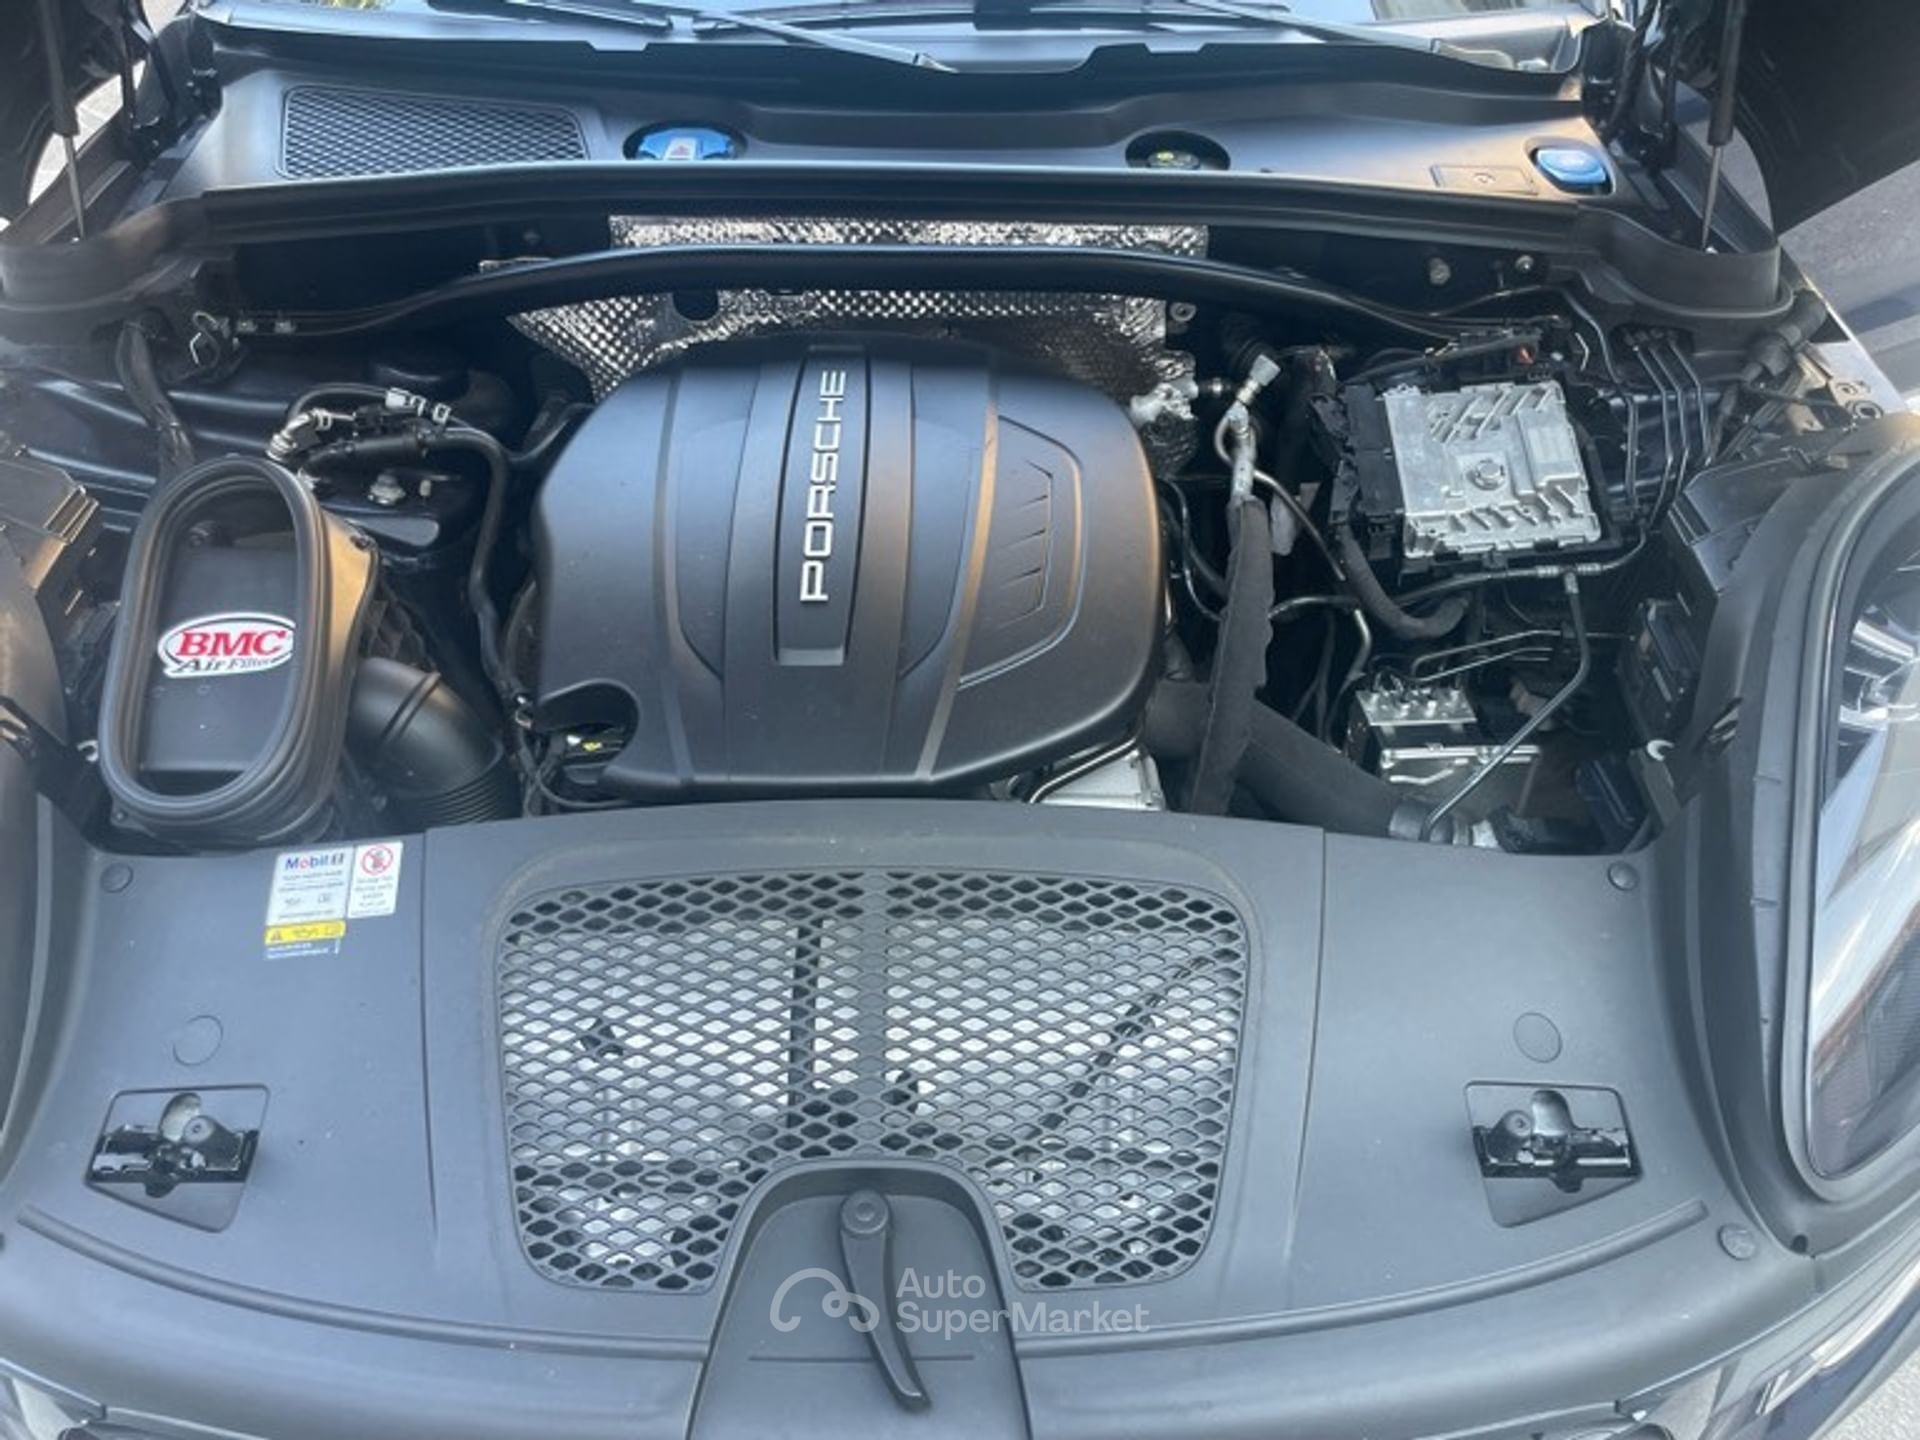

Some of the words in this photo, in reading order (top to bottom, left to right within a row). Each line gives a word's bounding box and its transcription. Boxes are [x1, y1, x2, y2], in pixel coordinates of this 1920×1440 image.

[800, 371, 846, 602] PORSCHE
[175, 630, 287, 656] BMC
[173, 658, 226, 673] Air
[285, 855, 329, 870] Mobil
